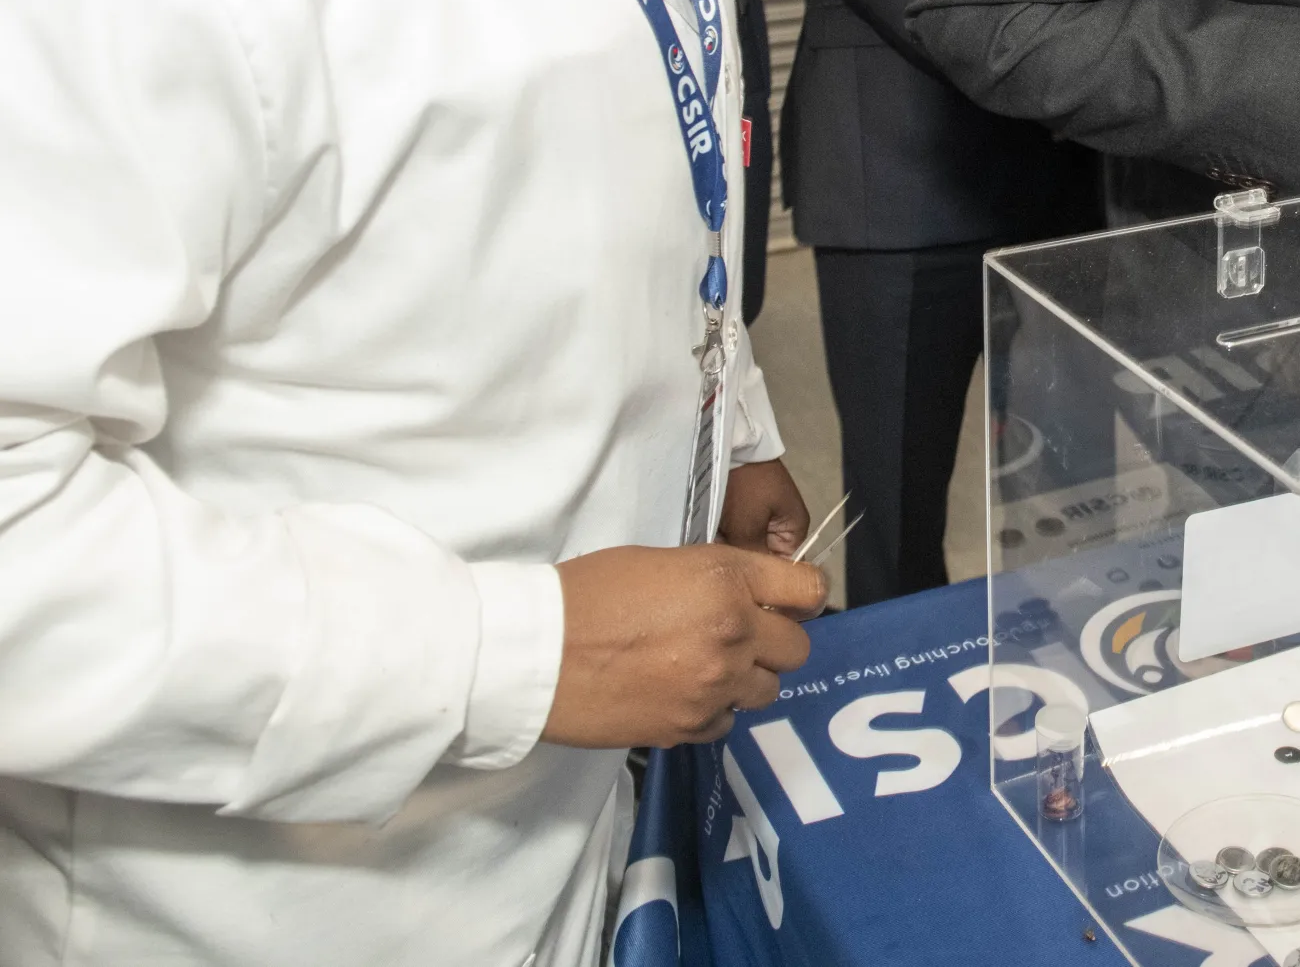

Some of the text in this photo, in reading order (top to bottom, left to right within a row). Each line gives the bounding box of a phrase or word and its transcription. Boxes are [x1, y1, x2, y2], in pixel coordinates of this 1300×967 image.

[677, 75, 712, 162] CSIR
[894, 635, 1001, 669] Touching
[778, 681, 829, 702] thro
[833, 663, 891, 686] lives
[722, 663, 1087, 930] CSIR
